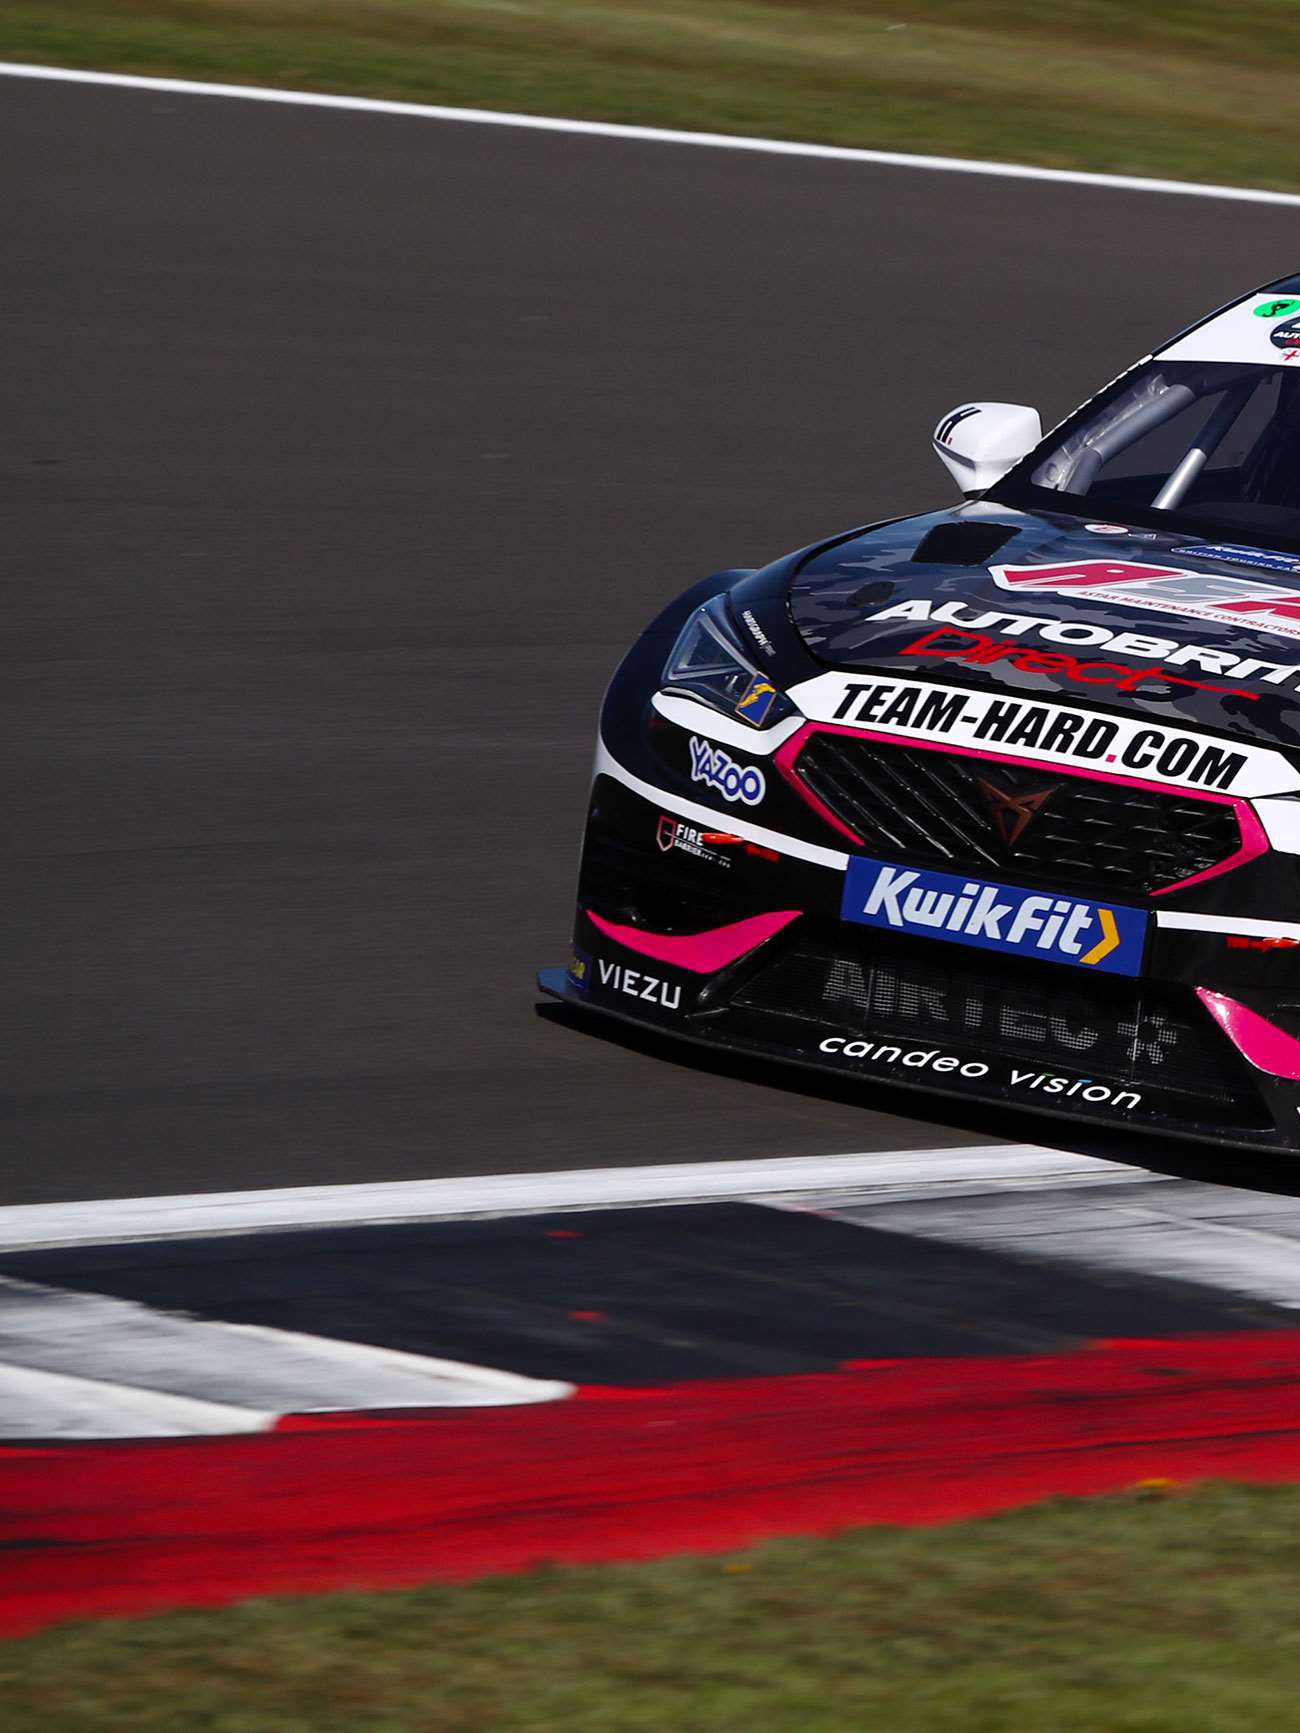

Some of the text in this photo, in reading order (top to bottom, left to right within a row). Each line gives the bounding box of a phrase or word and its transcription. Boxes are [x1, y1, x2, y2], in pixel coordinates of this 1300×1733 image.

[1121, 595, 1212, 618] MAINTENANCE
[900, 626, 1260, 701] Direct
[688, 735, 766, 806] YAZOO
[831, 682, 1249, 791] TEAM-HARD.COM
[676, 823, 704, 847] FIRE
[598, 958, 682, 1010] VIEZU
[818, 1036, 1142, 1109] candeo vision
